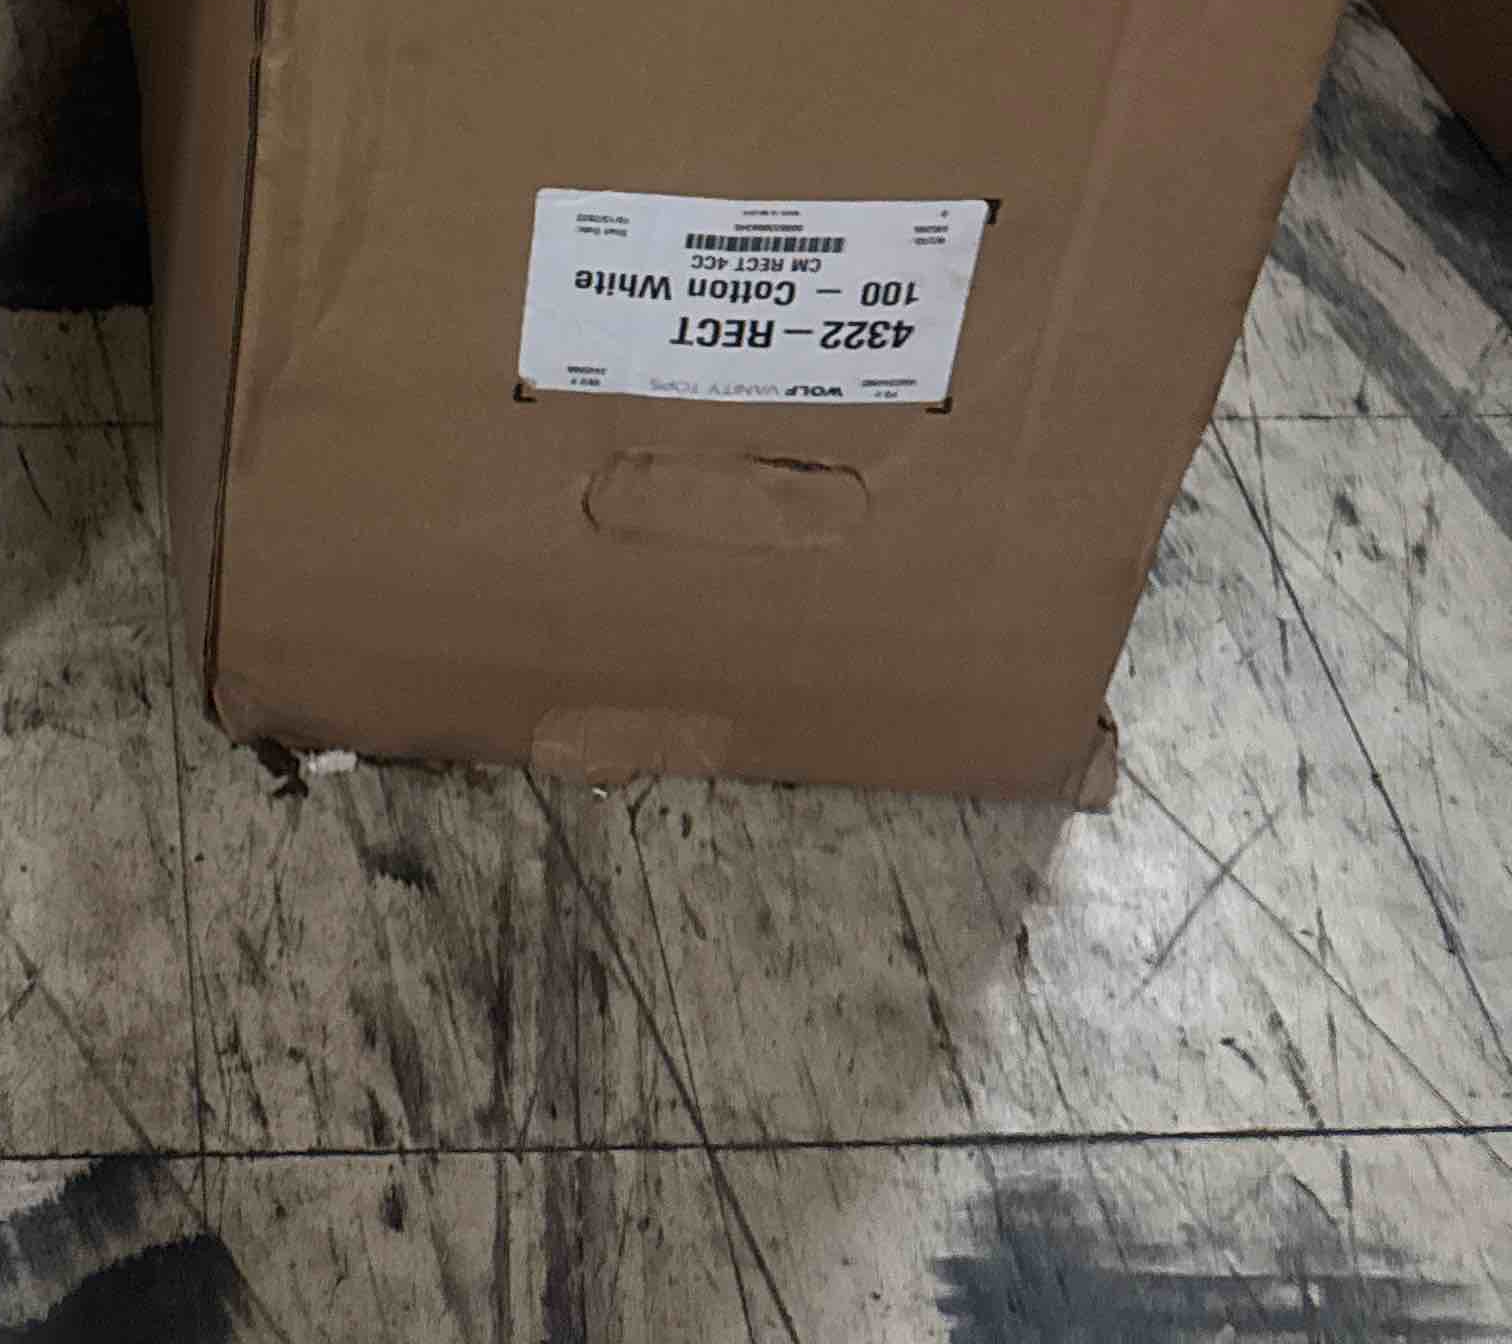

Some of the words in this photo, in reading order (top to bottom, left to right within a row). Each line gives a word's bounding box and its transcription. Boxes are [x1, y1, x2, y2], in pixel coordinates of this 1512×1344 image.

[691, 254, 729, 270] 4CC
[734, 256, 785, 273] RECT
[792, 257, 822, 273] CM
[574, 269, 673, 301] White
[688, 277, 796, 306] Cotton
[860, 281, 919, 307] 100
[669, 315, 775, 349] RECT
[820, 319, 915, 350] 4322
[785, 384, 844, 398] WOLF
